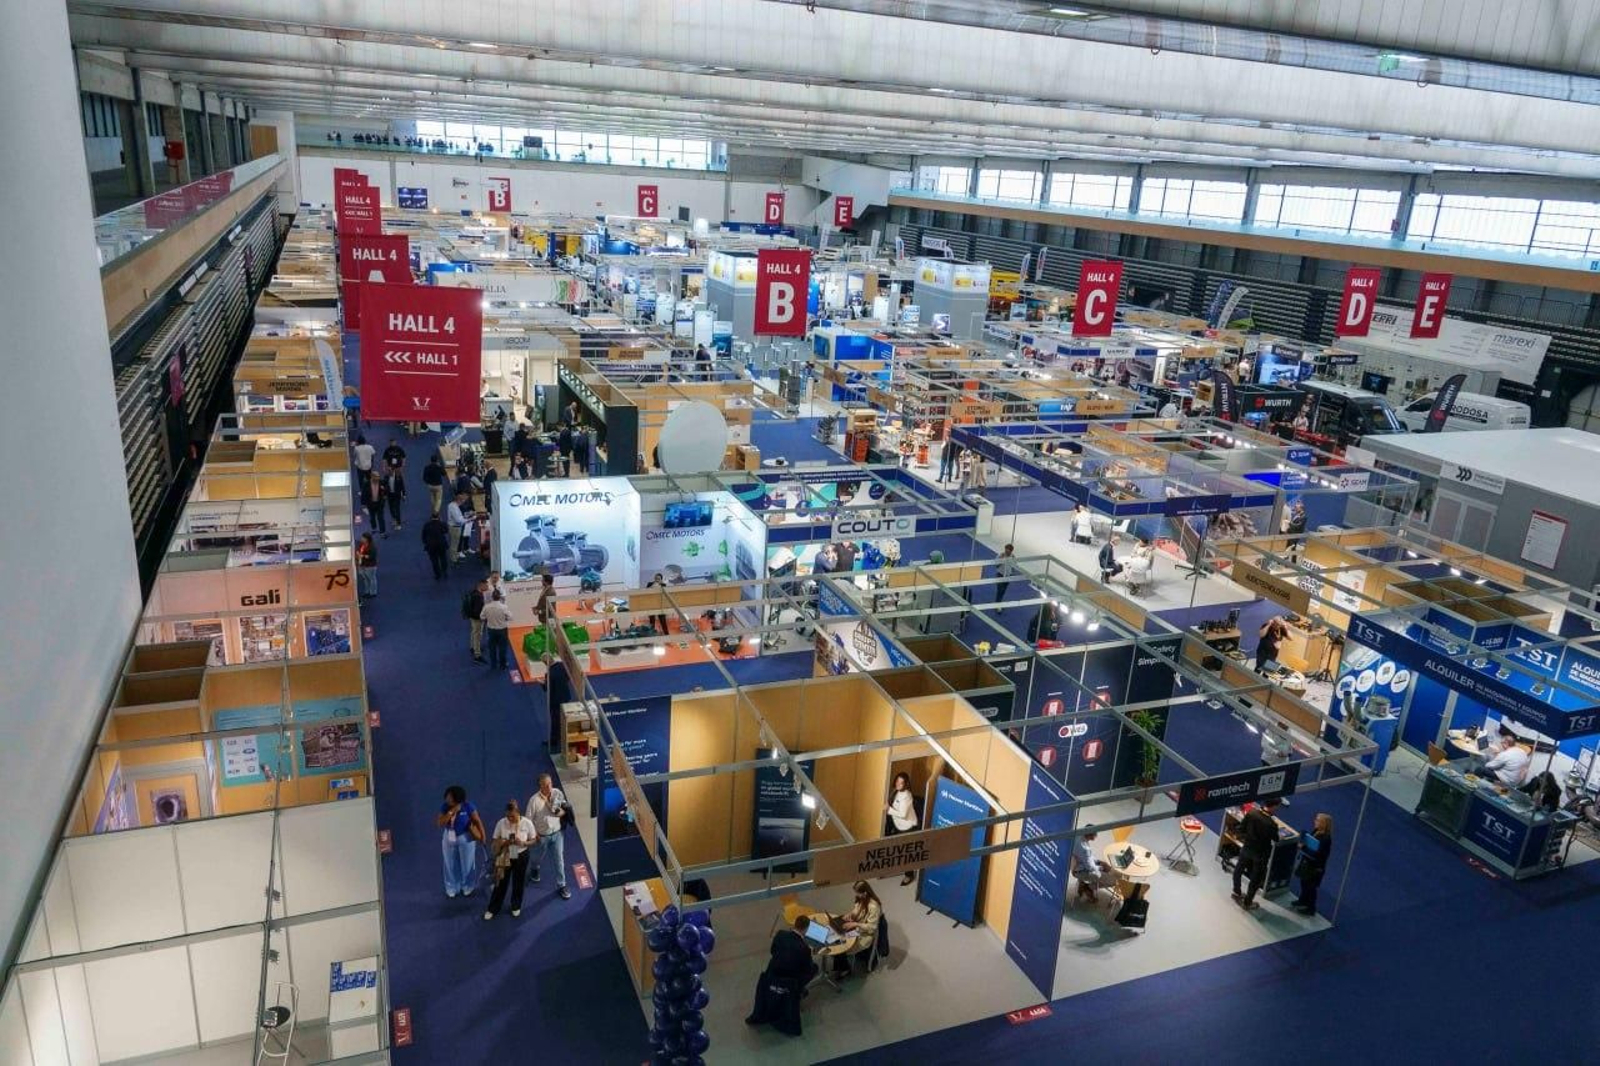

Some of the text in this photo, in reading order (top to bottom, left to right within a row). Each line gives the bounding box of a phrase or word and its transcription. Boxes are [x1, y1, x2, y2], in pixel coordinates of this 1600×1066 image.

[345, 195, 371, 205] HALL 4
[494, 191, 506, 208] B
[642, 197, 654, 213] C
[769, 204, 780, 220] D
[839, 207, 848, 222] E
[353, 247, 397, 261] HALL 4
[766, 263, 801, 274] HALL 4
[1087, 272, 1114, 282] HALL 4
[1351, 278, 1374, 287] HALL 4
[1425, 281, 1446, 291] HALL 4
[767, 281, 795, 324] B
[1084, 289, 1107, 325] C
[1345, 292, 1367, 326] D
[1419, 295, 1440, 328] E
[388, 313, 455, 334] HALL 4
[1492, 332, 1536, 349] marexi
[416, 351, 458, 365] HALL 1
[554, 491, 612, 507] MOTORS
[671, 529, 705, 539] MOTORS
[837, 518, 910, 534] COUTO
[323, 568, 350, 591] 75
[1355, 620, 1386, 646] TST
[1513, 636, 1558, 669] TST
[1424, 659, 1476, 690] ALQUILER
[1569, 715, 1597, 731] TST
[1207, 781, 1250, 798] ramtech
[1481, 811, 1516, 839] TST
[865, 840, 926, 861] NEUVER
[857, 851, 931, 874] MARITIME
